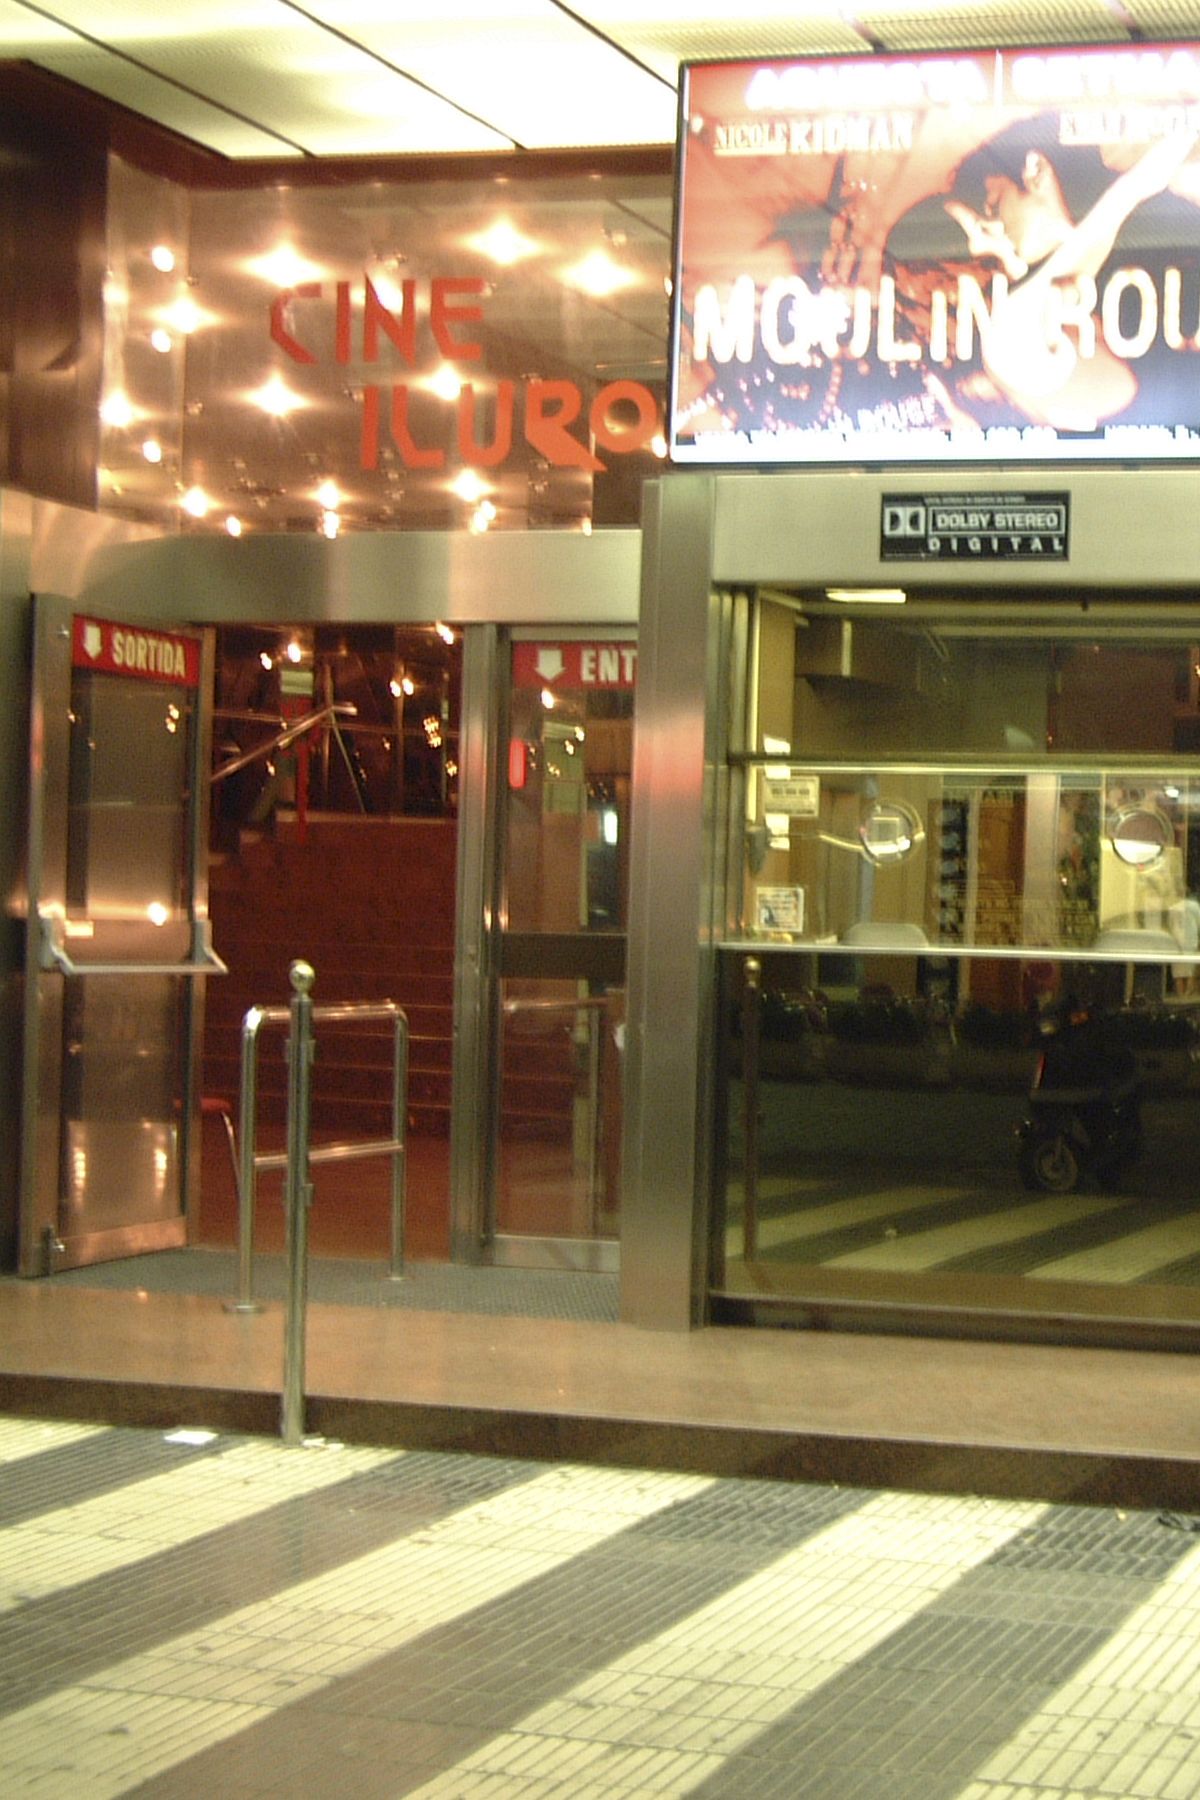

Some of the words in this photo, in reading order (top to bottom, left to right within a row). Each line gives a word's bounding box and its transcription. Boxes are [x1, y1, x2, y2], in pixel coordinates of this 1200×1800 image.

[714, 119, 787, 150] NICOLE
[788, 110, 914, 155] KIDMAN
[269, 274, 486, 370] CINE
[693, 271, 1007, 365] MOULIN
[361, 379, 658, 471] ILURO
[936, 513, 991, 529] DOLBY
[994, 512, 1059, 529] STEREO
[928, 537, 1063, 553] DIGITAL
[112, 631, 186, 678] SORTIDA
